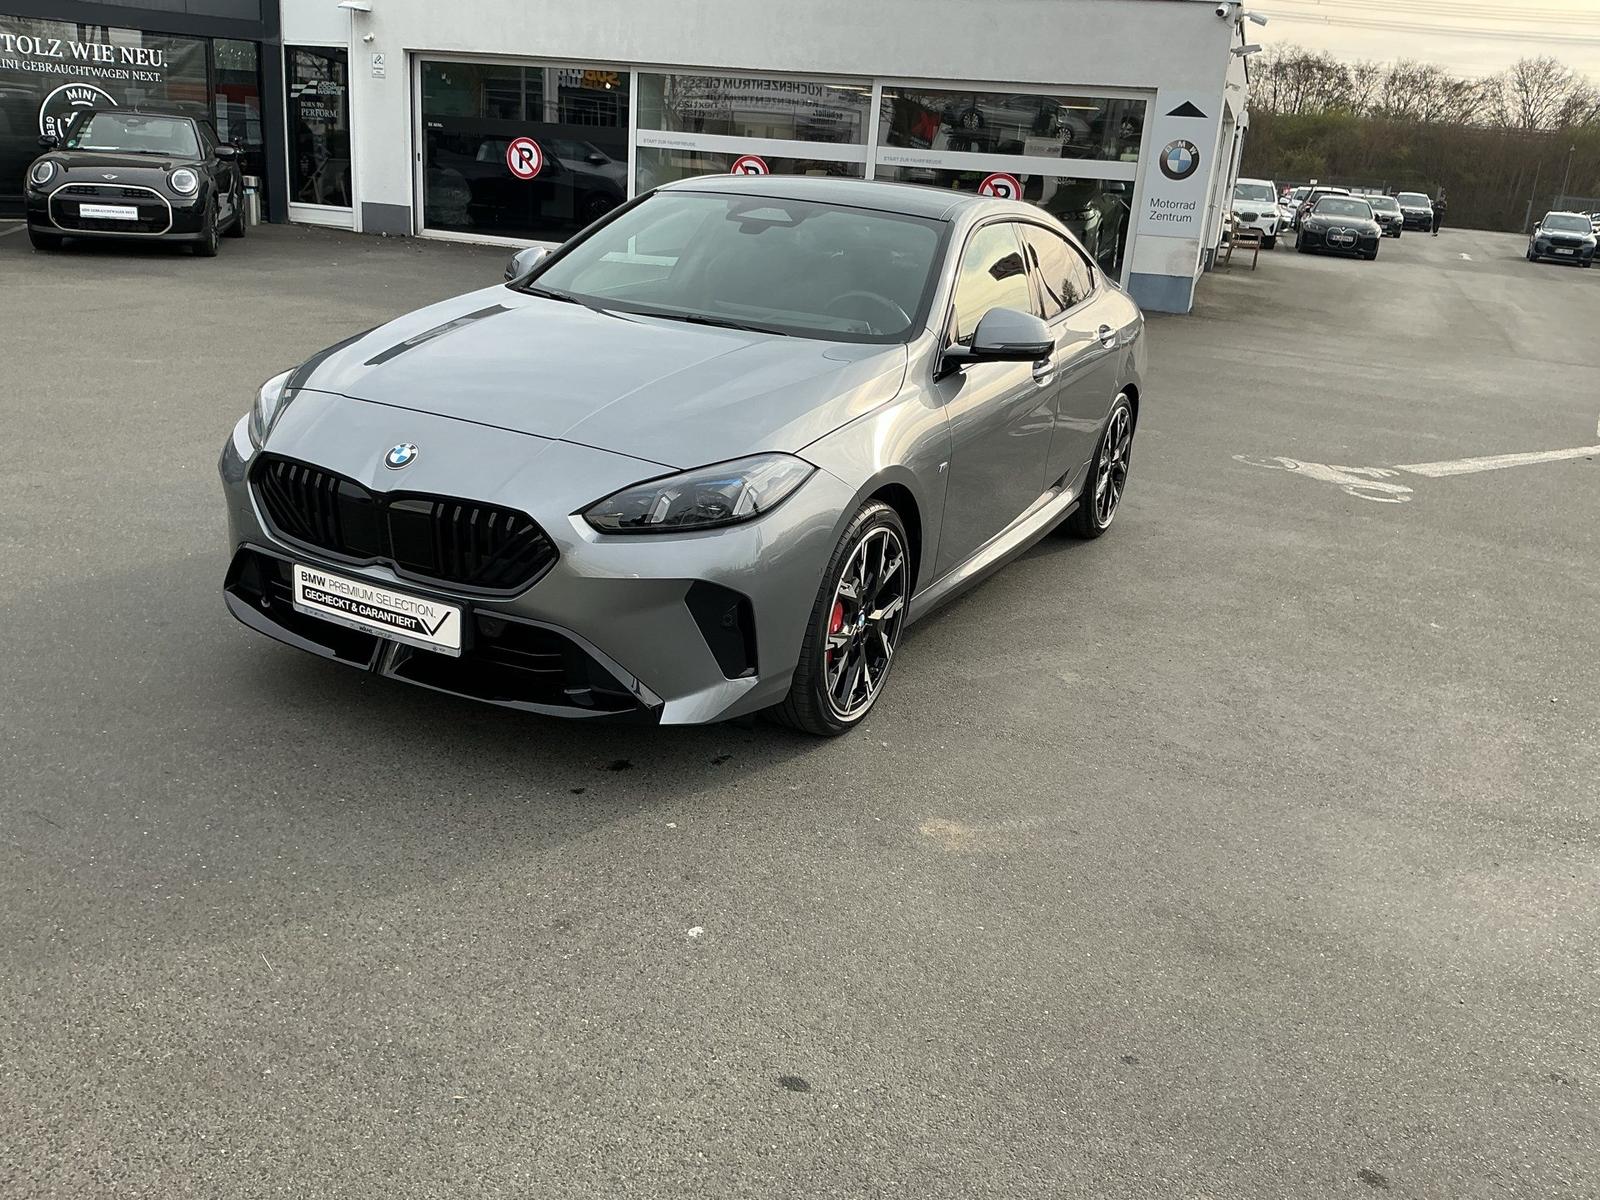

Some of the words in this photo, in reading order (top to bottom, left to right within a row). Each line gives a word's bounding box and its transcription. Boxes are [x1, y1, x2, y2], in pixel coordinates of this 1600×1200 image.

[67, 40, 115, 63] WIE
[120, 46, 168, 68] NEU.
[0, 58, 19, 69] INI
[22, 61, 129, 80] GEBRAUCHTWAGEN
[132, 71, 163, 82] NEXT.
[66, 89, 96, 101] MINI
[1149, 210, 1192, 222] Zentrum
[1150, 198, 1196, 210] Motorrad
[301, 571, 326, 587] BMW
[328, 579, 374, 600] PREMIUM
[375, 592, 437, 619] SELECTION.
[305, 588, 351, 610] GECHECKT
[351, 603, 358, 611] &
[358, 604, 418, 629] GARANTIERT
